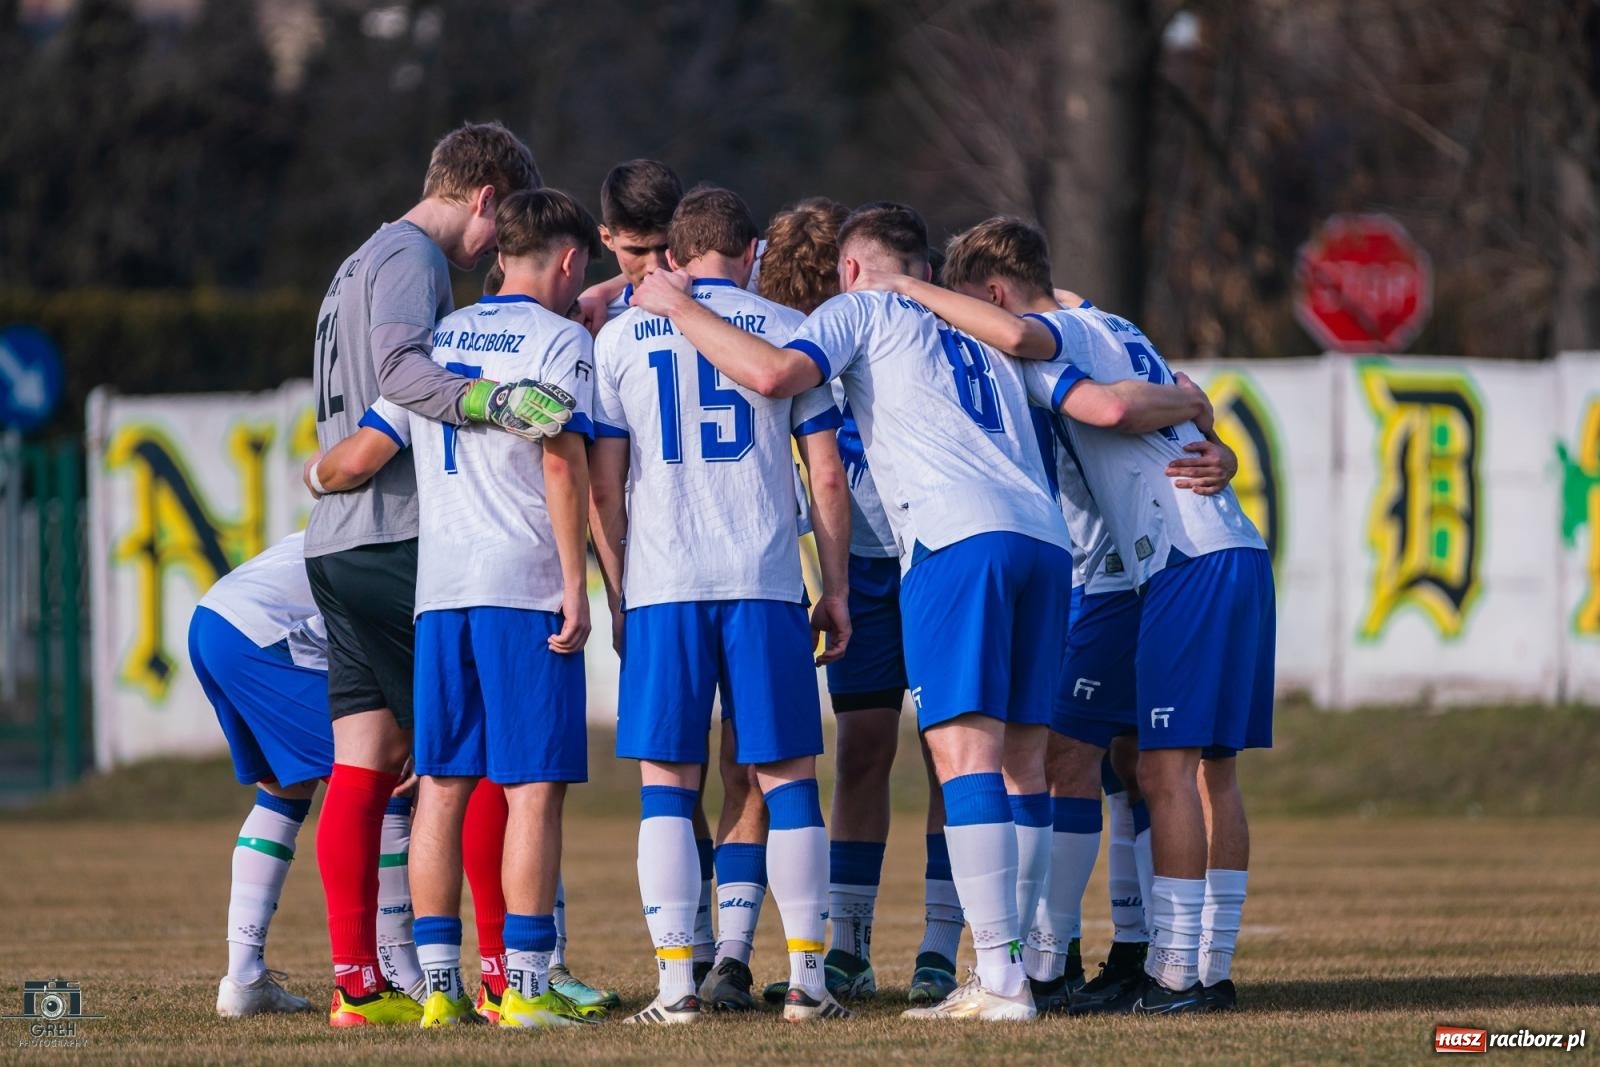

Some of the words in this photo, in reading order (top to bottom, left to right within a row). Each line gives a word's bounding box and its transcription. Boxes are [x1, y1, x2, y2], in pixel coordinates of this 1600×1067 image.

[456, 329, 526, 353] RACIBÓRZ
[634, 317, 674, 341] UNIA
[648, 349, 756, 465] 15
[719, 897, 758, 910] saller
